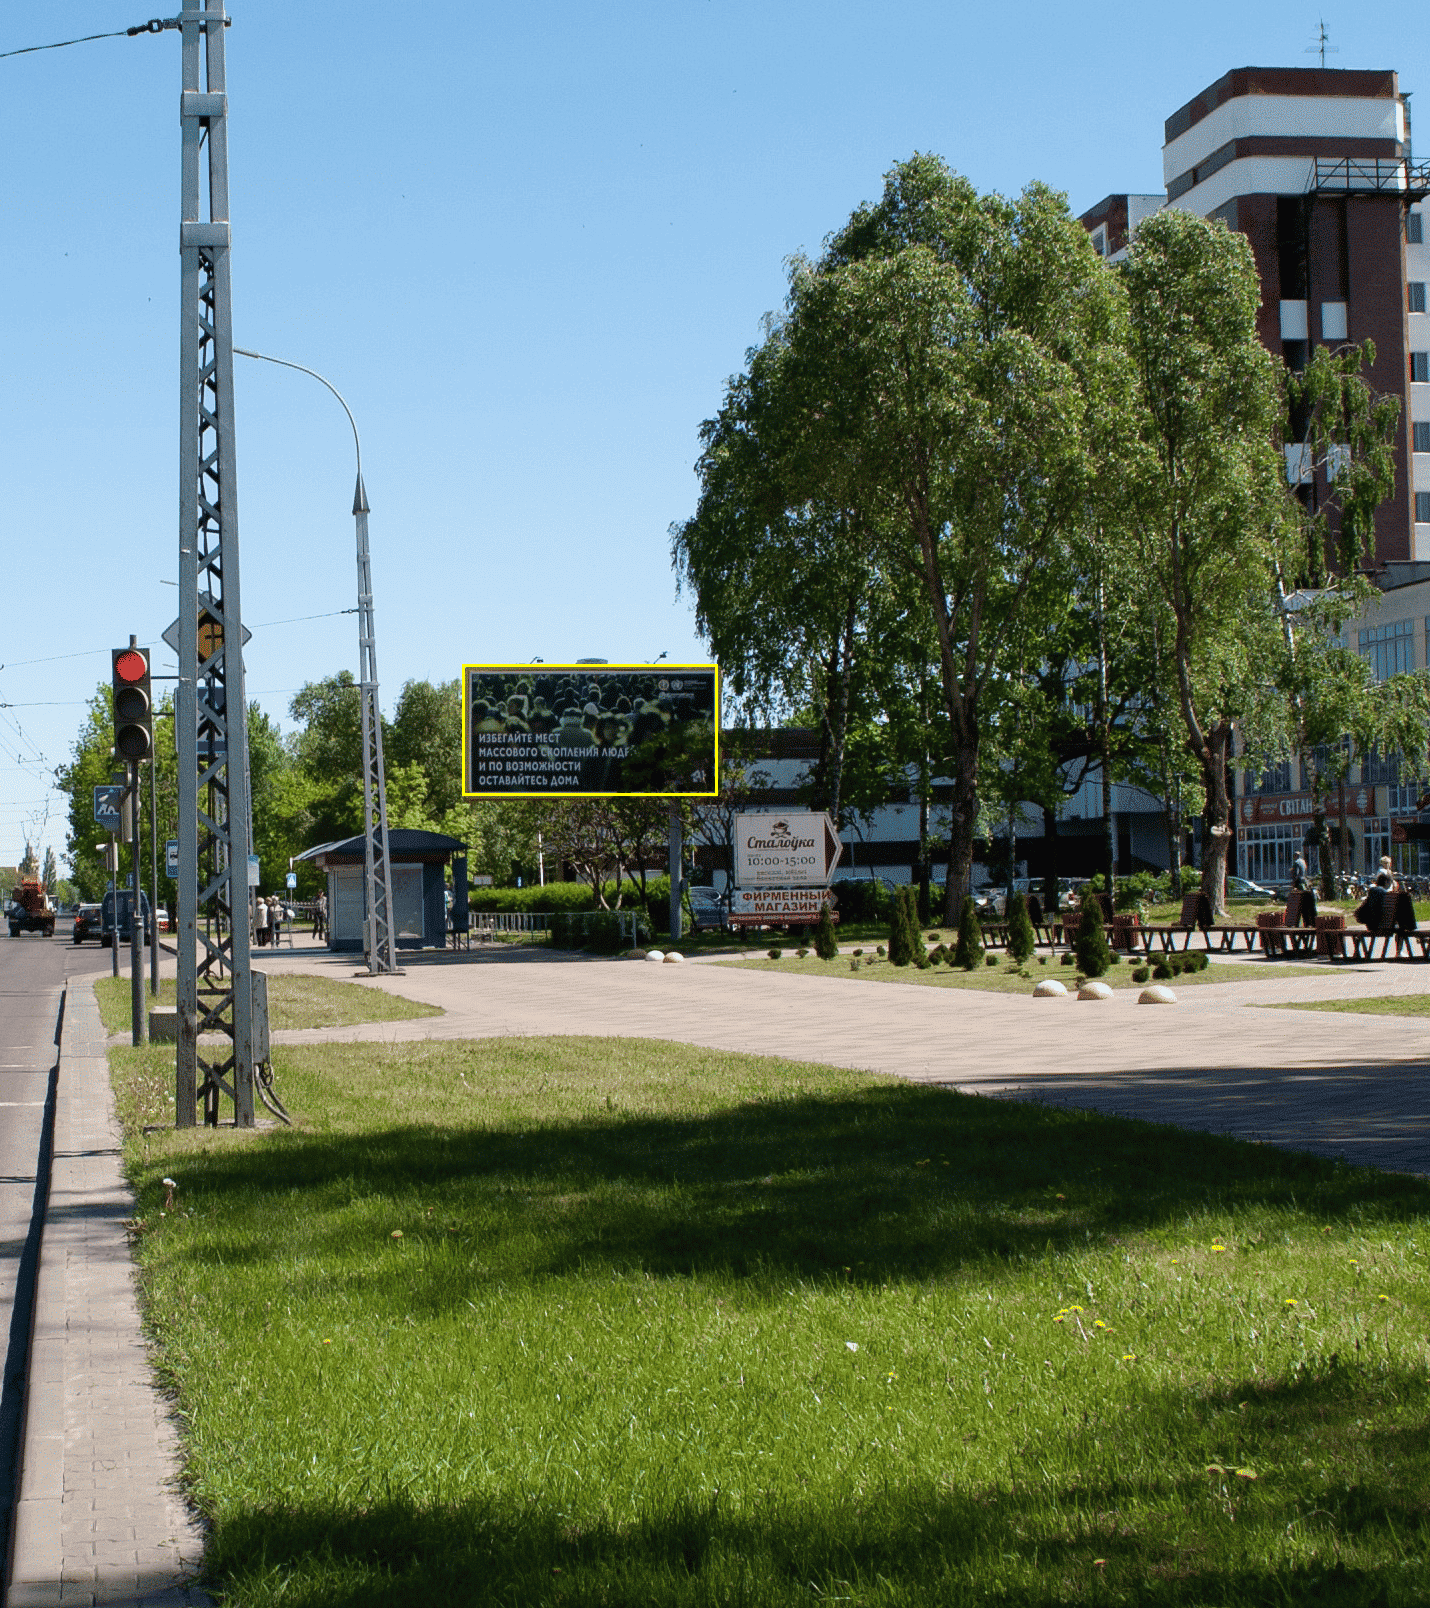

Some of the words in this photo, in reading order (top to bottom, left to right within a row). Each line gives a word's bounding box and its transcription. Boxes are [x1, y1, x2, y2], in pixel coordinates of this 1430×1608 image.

[479, 731, 532, 743] ИЗБЕГАЙТЕ
[536, 733, 560, 743] МЕСТ
[479, 747, 538, 757] МАССОВОГО
[540, 747, 599, 757] СКОПЛЕНИЯ
[479, 761, 486, 771] И
[489, 761, 503, 771] ПО
[505, 761, 581, 771] ВОЗМОЖНОСТИ
[479, 773, 548, 785] ОСТАВАЙТЕСЬ
[550, 775, 580, 786] ДОМА
[747, 836, 815, 852] Сталоўка
[747, 856, 816, 867] 10:00-15:00
[742, 890, 831, 901] ФИРМЕННЫЙ
[754, 902, 818, 911] МАГАЗИН
